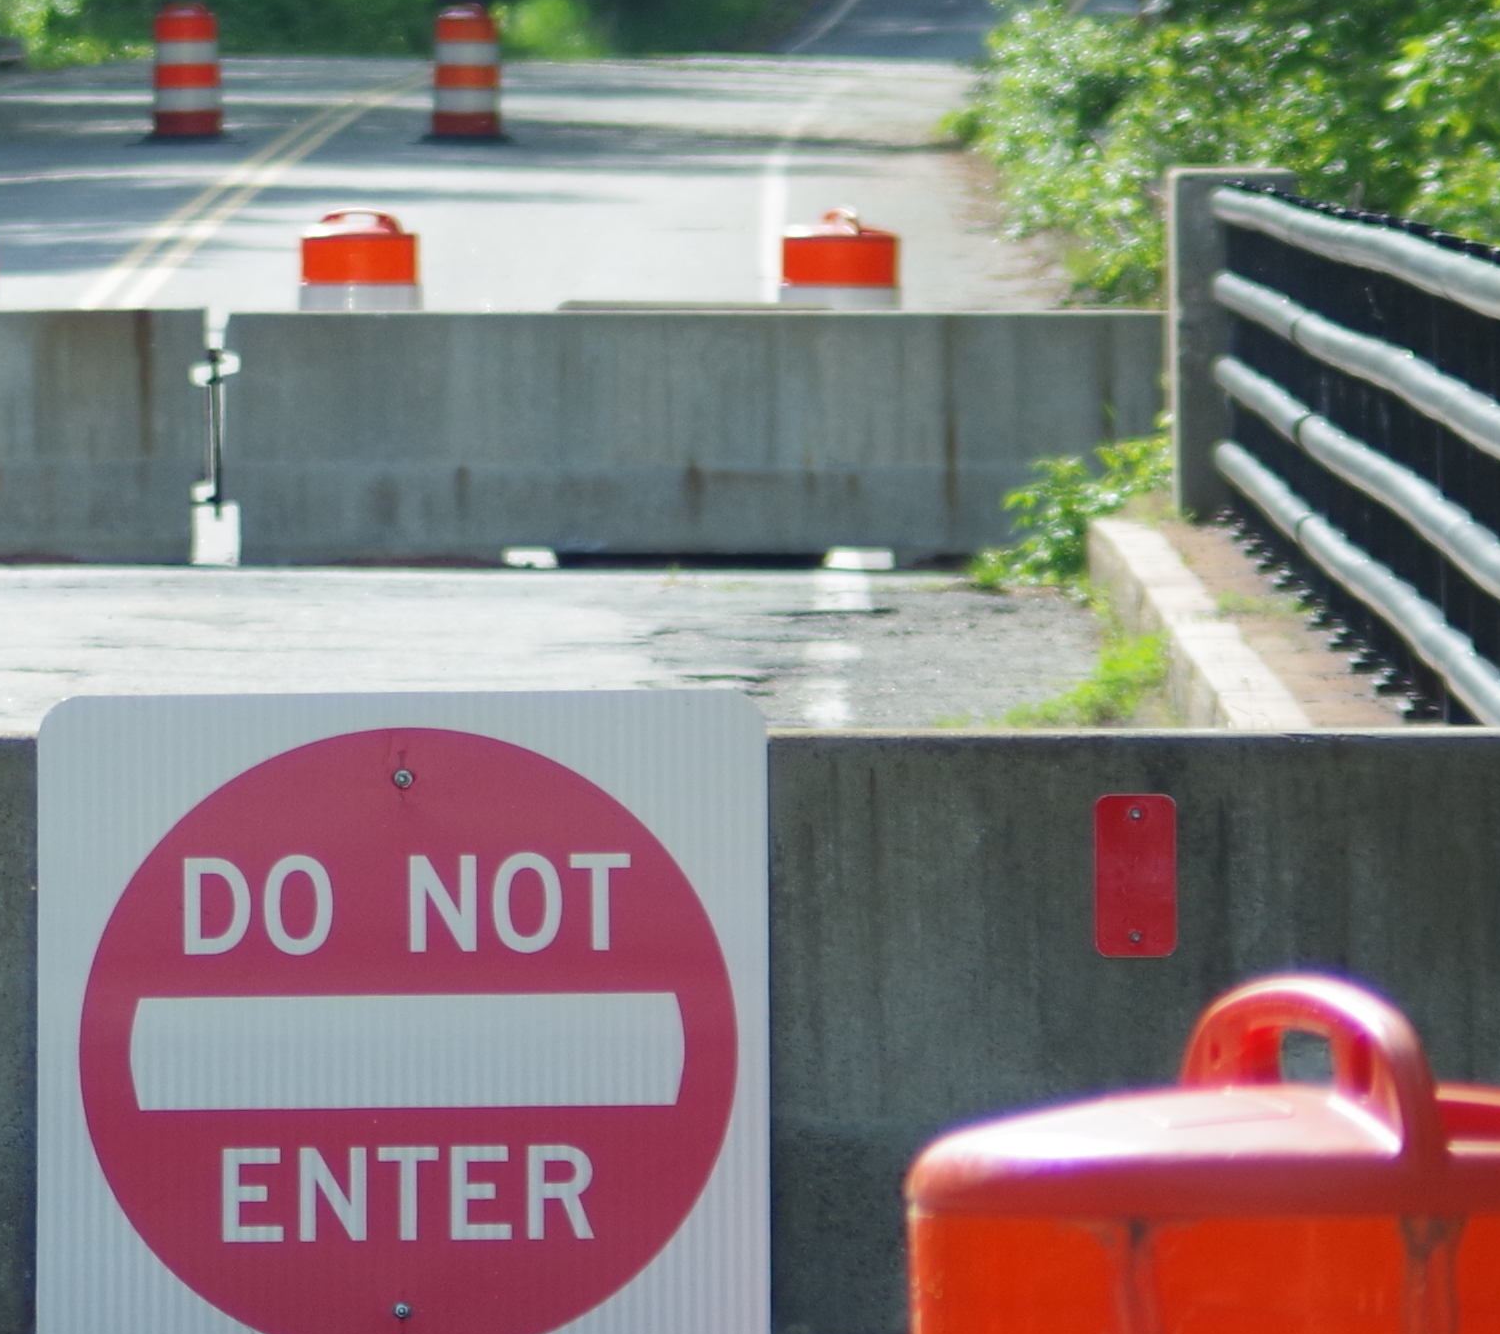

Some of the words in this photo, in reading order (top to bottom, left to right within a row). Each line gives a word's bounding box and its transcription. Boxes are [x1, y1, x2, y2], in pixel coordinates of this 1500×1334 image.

[183, 855, 333, 956] DO
[408, 852, 631, 954] NOT
[222, 1144, 595, 1243] ENTER
